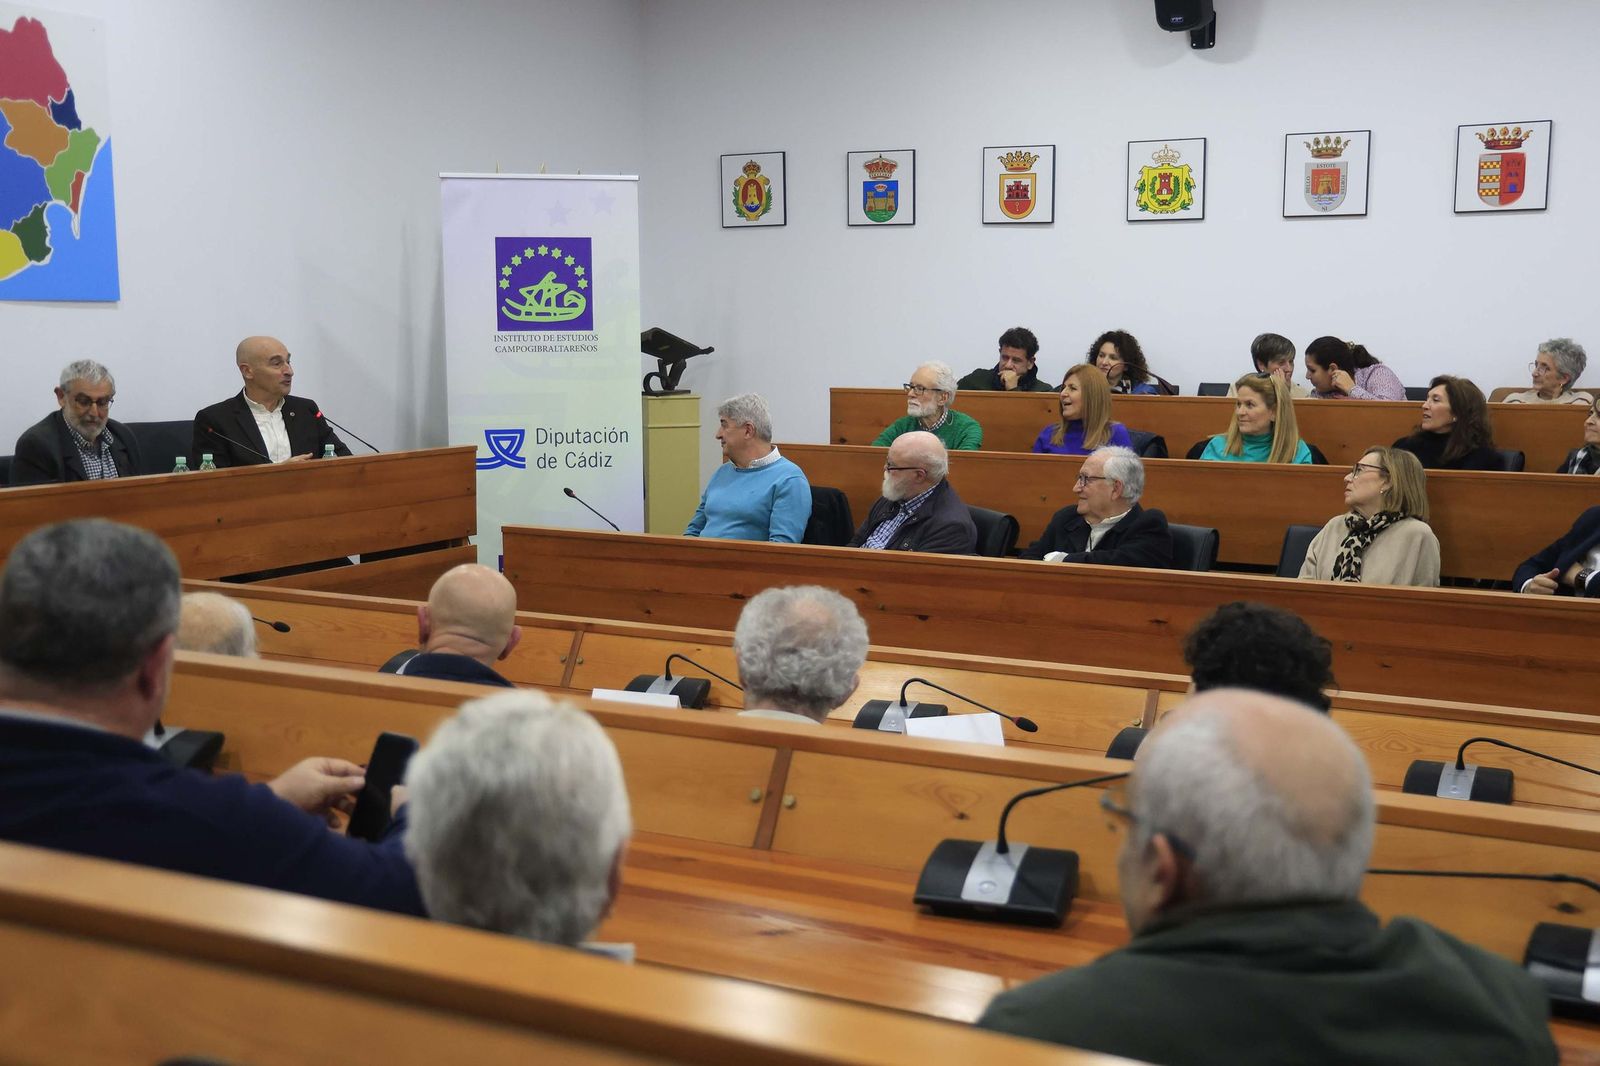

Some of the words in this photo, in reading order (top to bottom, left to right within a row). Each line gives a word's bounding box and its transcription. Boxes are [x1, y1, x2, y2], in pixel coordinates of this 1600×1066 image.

[494, 334, 541, 342] INSTITUTO
[543, 334, 556, 342] DE
[494, 343, 598, 353] CAMPOGIBRALTAREÑOS
[536, 427, 629, 447] Diputación
[536, 453, 558, 469] de
[565, 451, 613, 469] Cádiz
